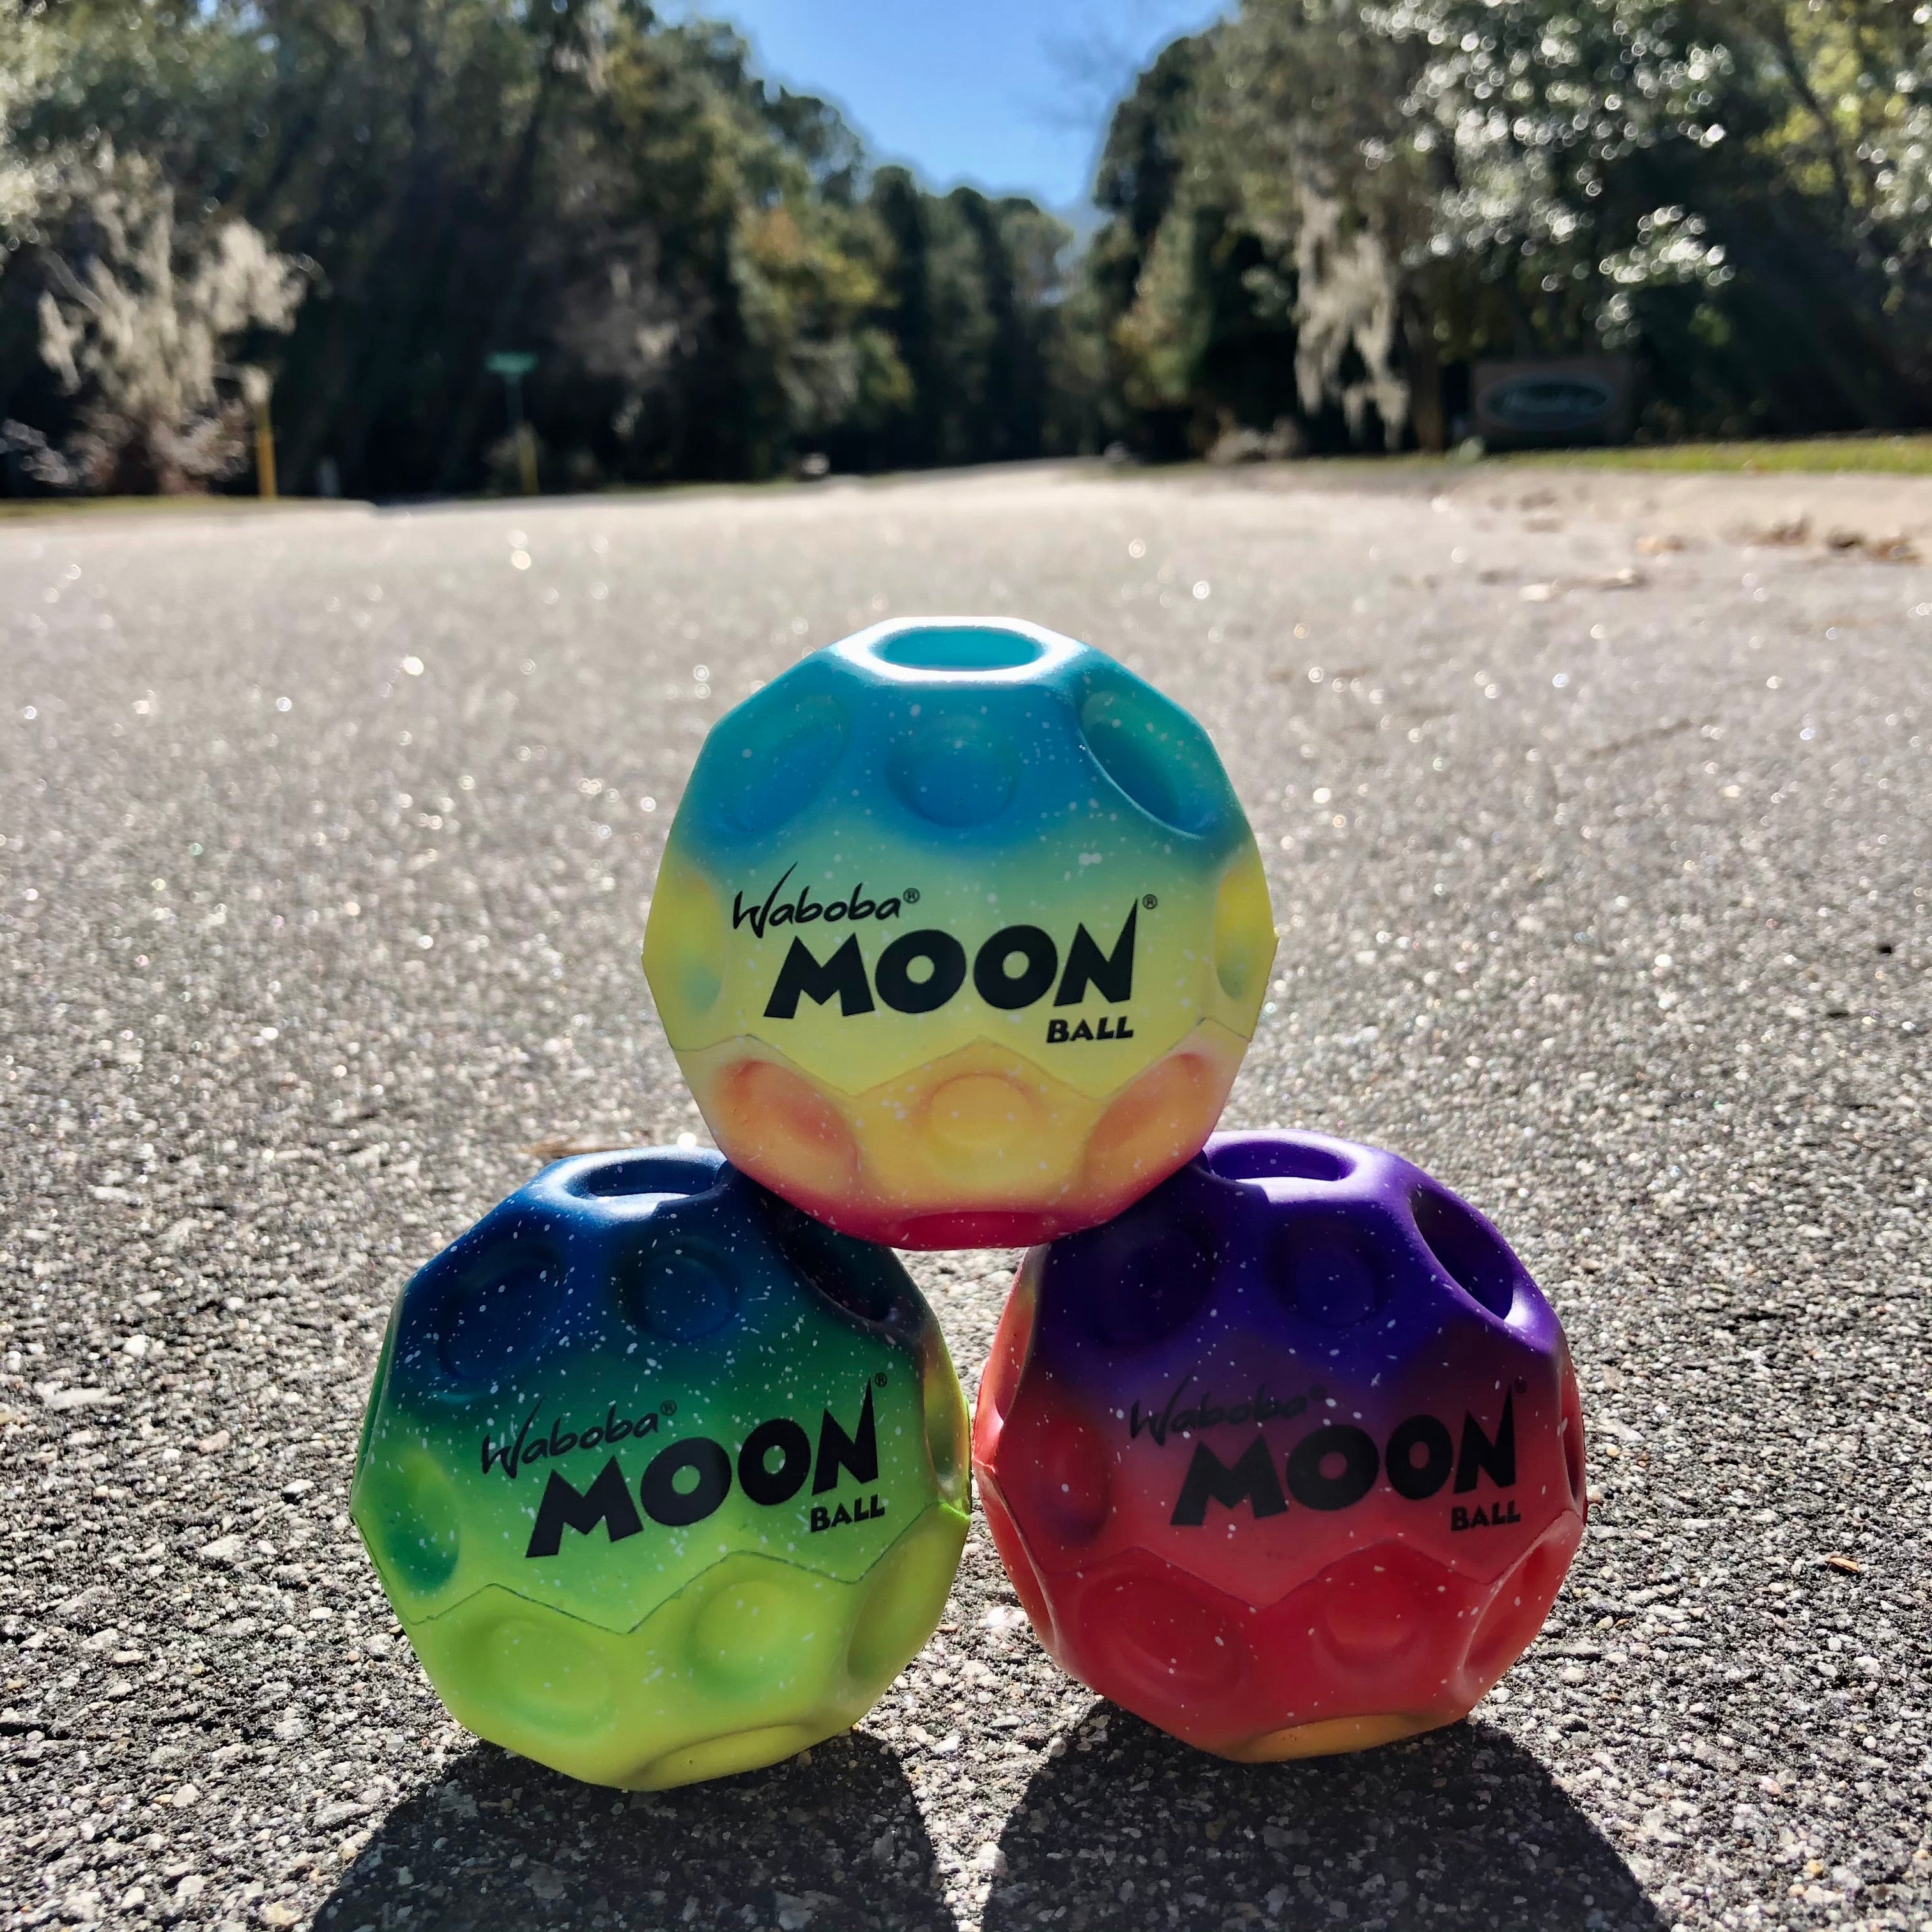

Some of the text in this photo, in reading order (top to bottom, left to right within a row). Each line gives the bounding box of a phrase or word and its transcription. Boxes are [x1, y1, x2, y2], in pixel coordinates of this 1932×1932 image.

[1046, 1015, 1134, 1043] BALL
[810, 1494, 885, 1533] BALL
[1450, 1500, 1521, 1531] BALL
